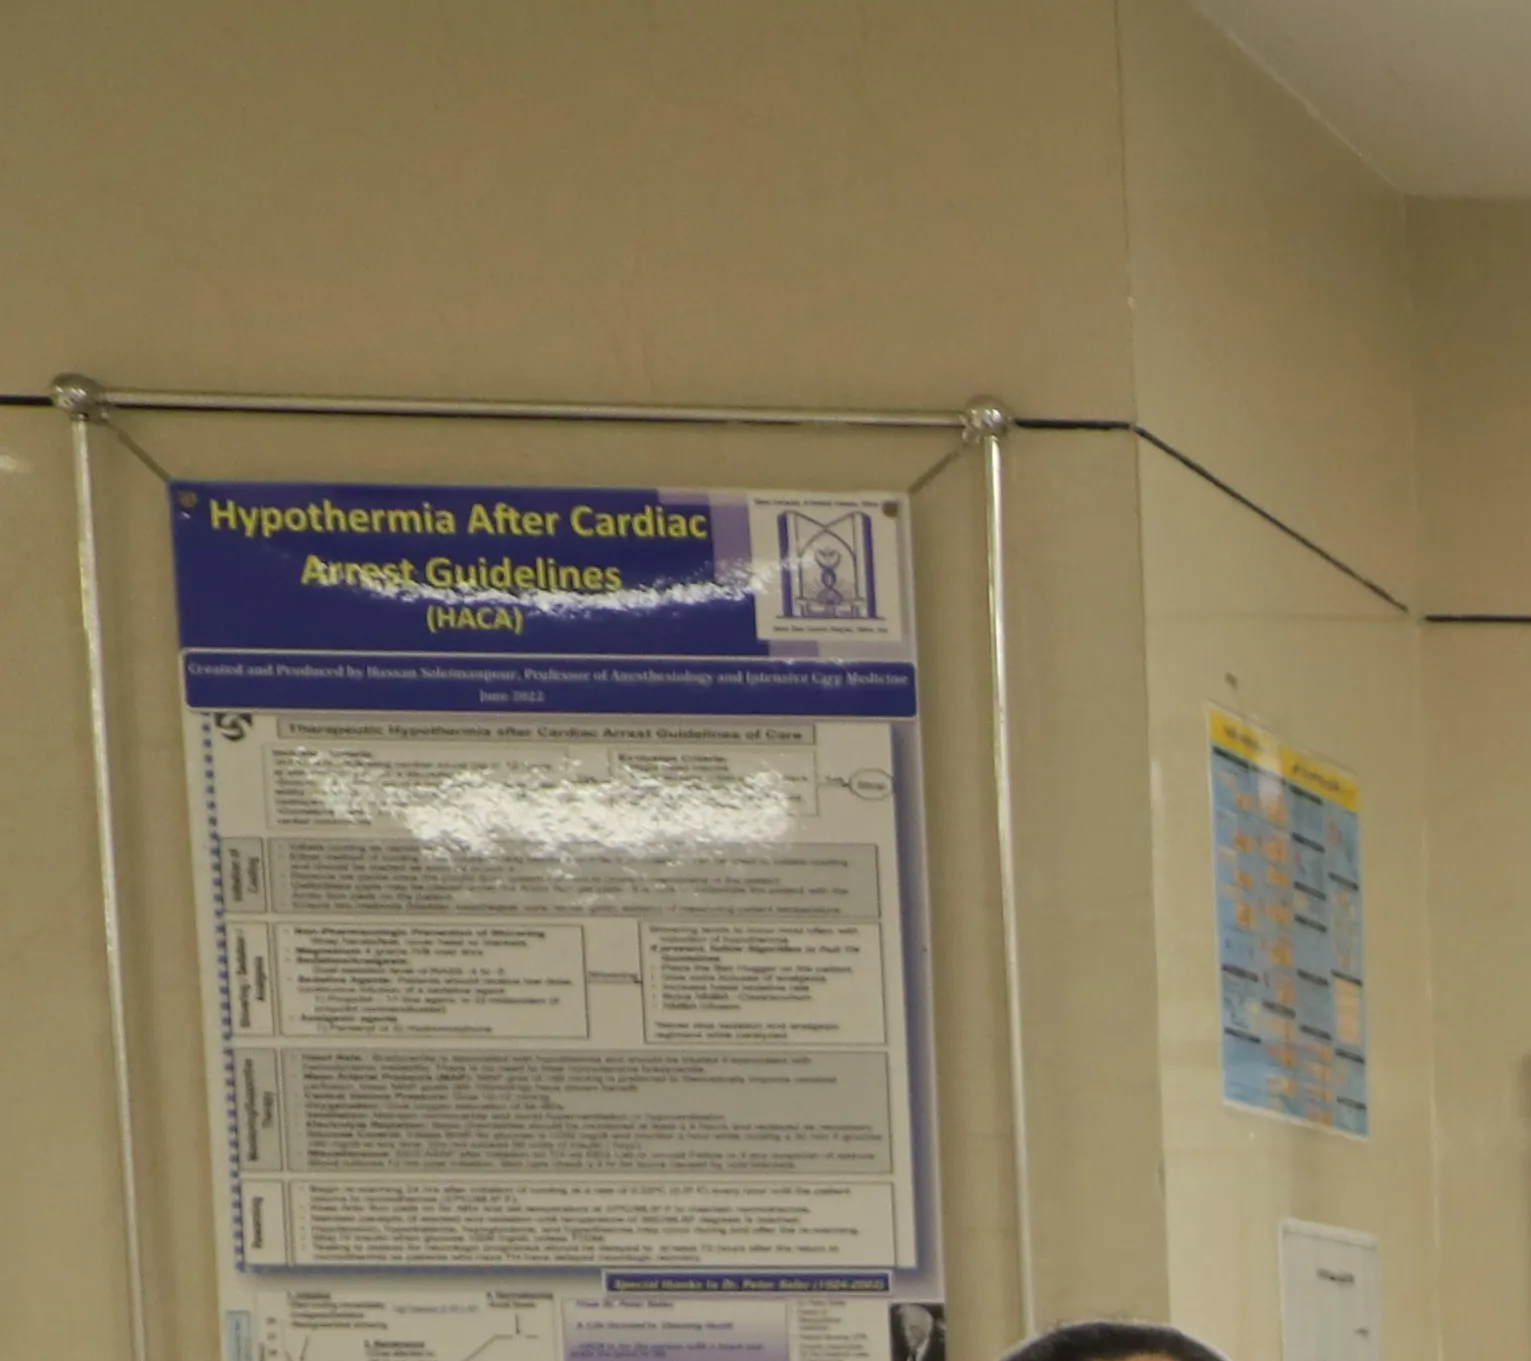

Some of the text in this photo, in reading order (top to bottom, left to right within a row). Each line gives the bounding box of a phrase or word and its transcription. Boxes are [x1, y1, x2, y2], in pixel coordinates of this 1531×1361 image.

[209, 498, 708, 539] Hypothermia After Cardiac
[301, 553, 623, 592] Arrest Guidelines
[425, 604, 525, 636] (HACA)
[187, 661, 244, 677] Created
[247, 662, 273, 677] and
